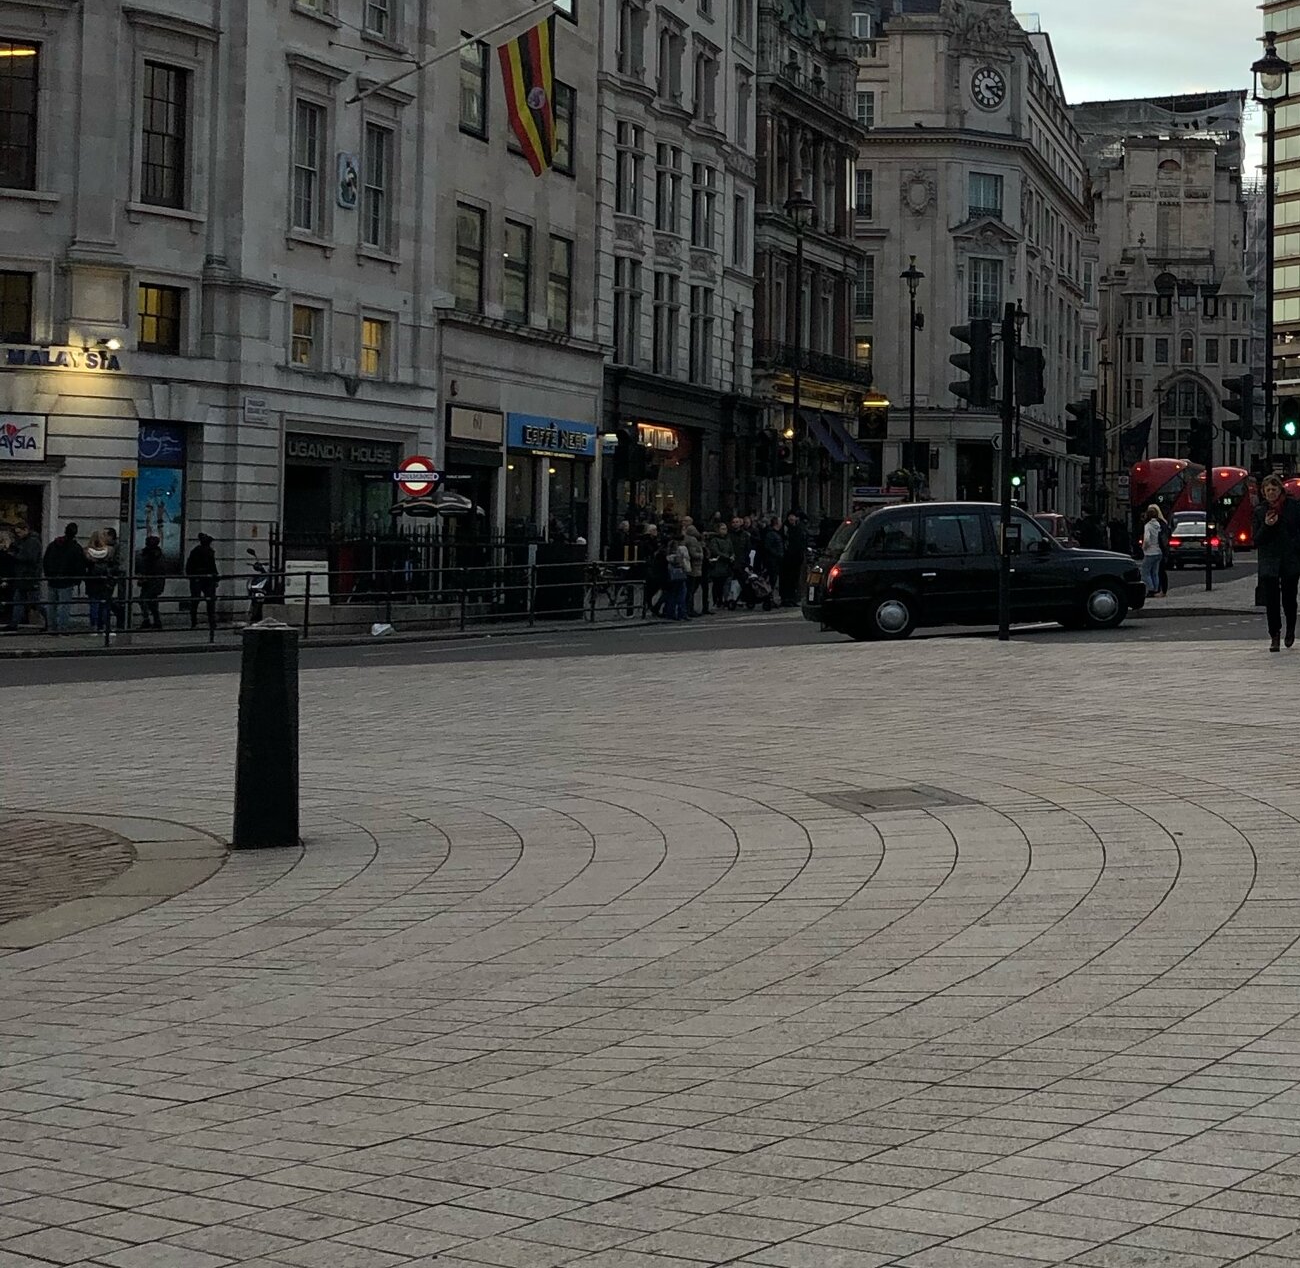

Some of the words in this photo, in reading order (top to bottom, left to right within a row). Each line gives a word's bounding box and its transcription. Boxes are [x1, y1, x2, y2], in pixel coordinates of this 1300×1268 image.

[8, 348, 120, 370] MALAYSIA
[558, 429, 588, 451] NERO
[288, 440, 344, 460] UGANDA
[350, 444, 392, 464] HOUSE
[1158, 495, 1164, 503] 9
